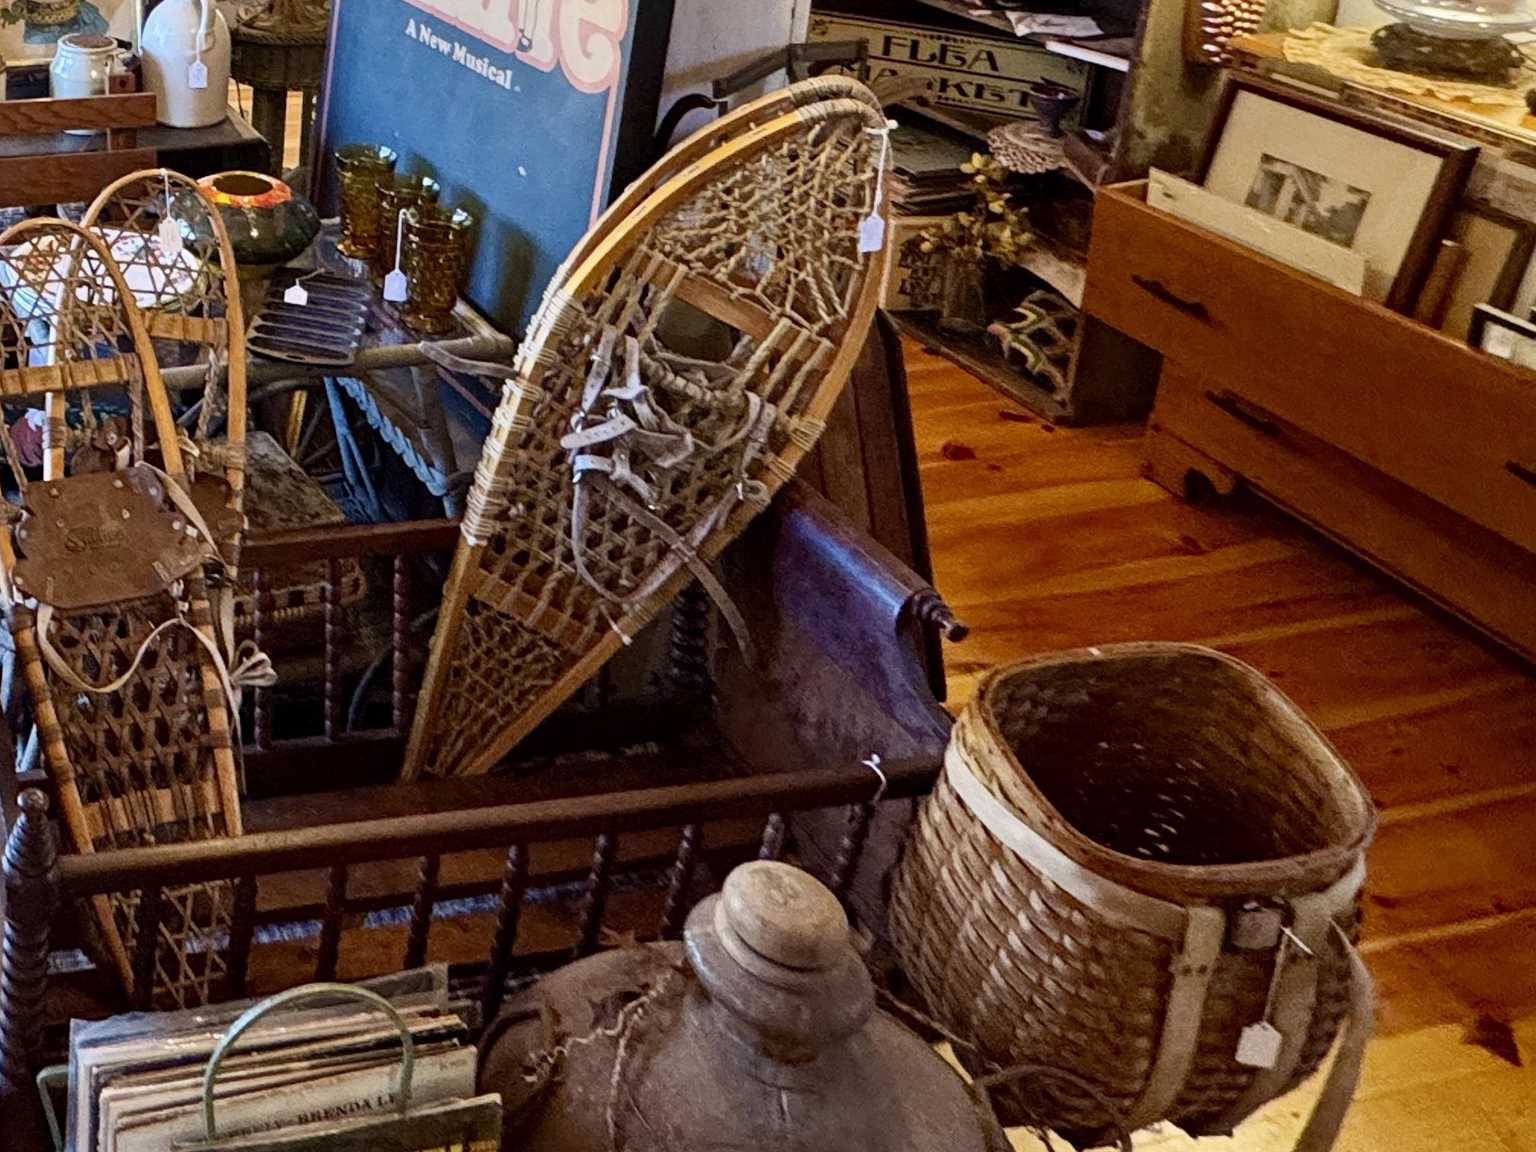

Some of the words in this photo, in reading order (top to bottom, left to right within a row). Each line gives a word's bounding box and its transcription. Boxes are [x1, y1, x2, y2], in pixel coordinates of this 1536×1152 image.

[405, 17, 418, 40] A
[418, 23, 452, 56] New
[451, 41, 513, 91] Musical
[881, 34, 1000, 72] FLEA
